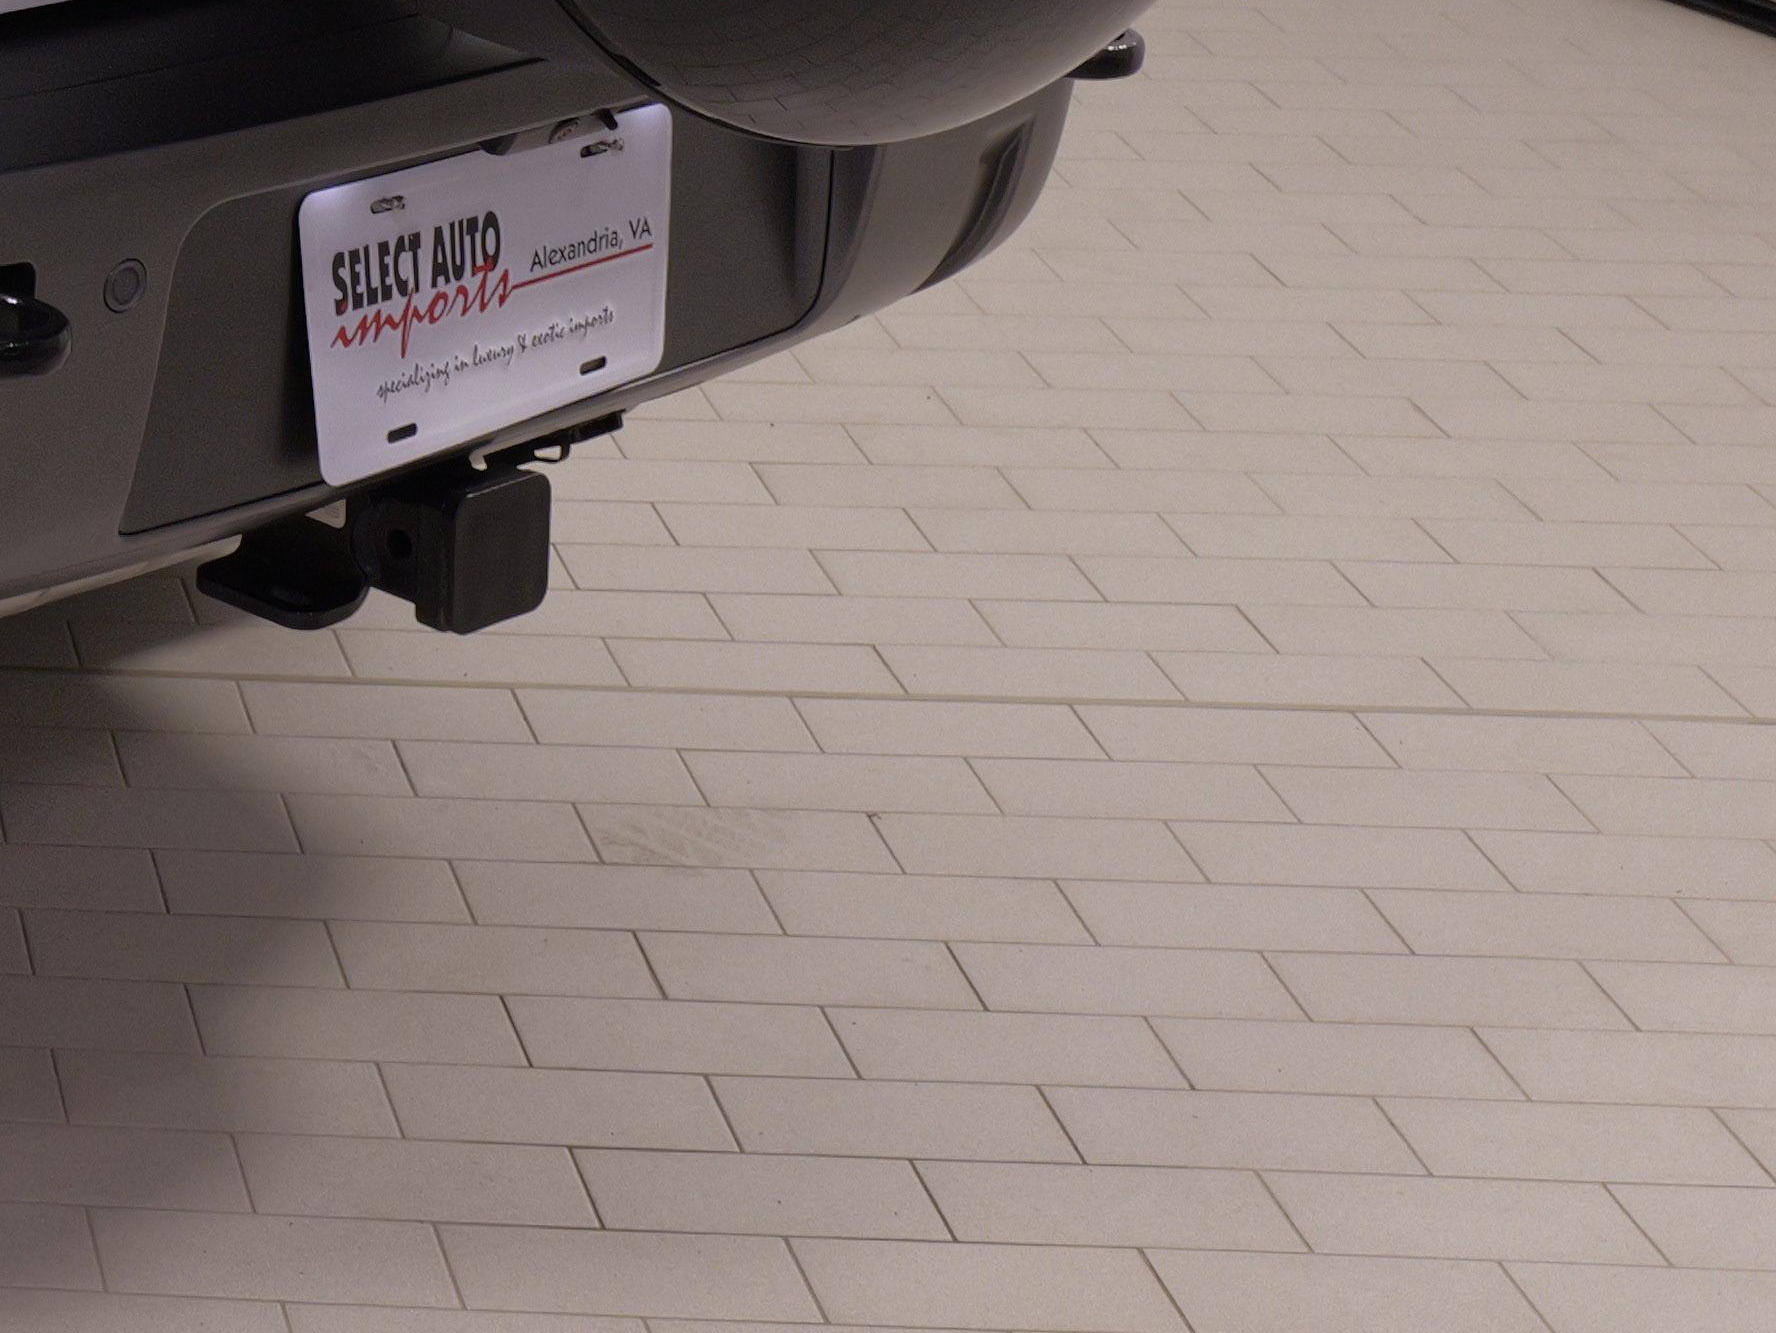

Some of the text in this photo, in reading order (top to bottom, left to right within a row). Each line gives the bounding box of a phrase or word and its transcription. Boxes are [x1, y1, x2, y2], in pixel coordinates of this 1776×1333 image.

[332, 210, 501, 316] SELECT AUTO
[529, 216, 652, 273] Alexandria, VA
[330, 255, 516, 359] imports
[376, 360, 451, 404] specializing
[453, 354, 470, 373] in
[472, 343, 515, 367] luxury
[531, 322, 565, 349] exotic
[568, 306, 614, 338] imports
